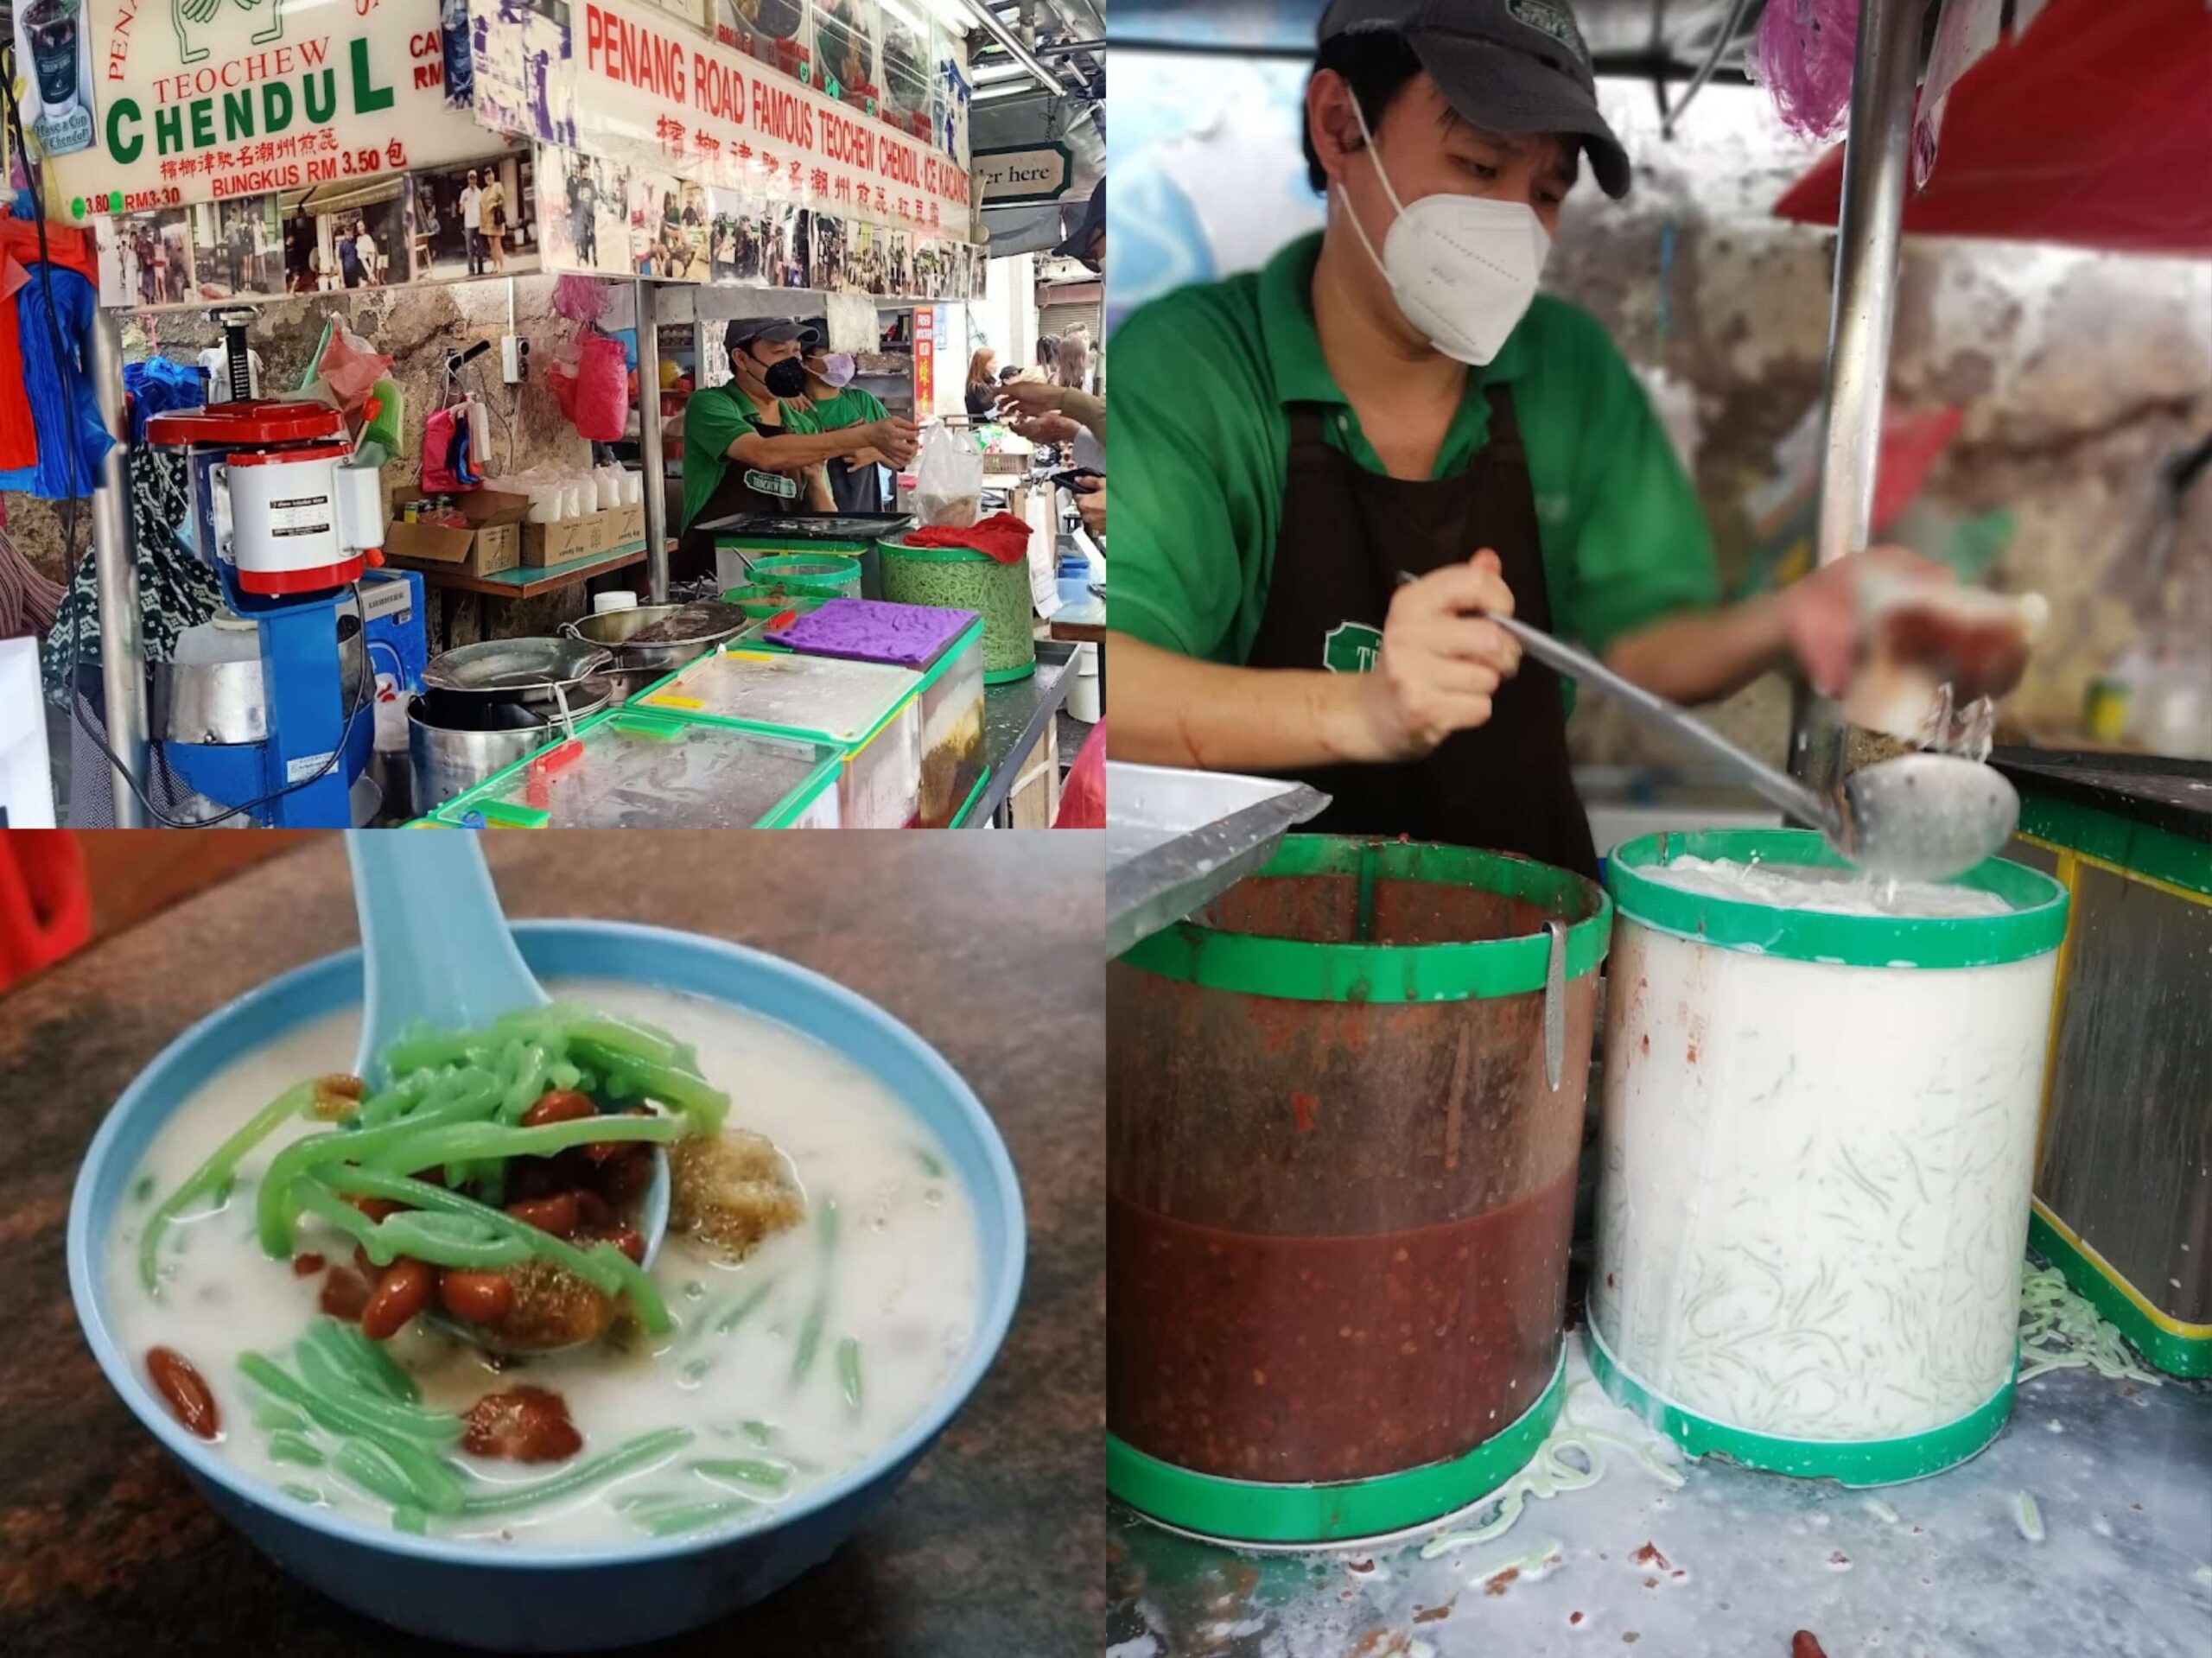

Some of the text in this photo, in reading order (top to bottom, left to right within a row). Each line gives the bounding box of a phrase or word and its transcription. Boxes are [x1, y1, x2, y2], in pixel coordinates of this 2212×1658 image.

[108, 0, 137, 82] PEN
[152, 36, 331, 105] TEOCHEW
[106, 37, 395, 165] CHENDUL
[586, 3, 685, 104] PENANG
[694, 52, 746, 124] ROAD
[753, 79, 813, 150] FAMOUS
[818, 109, 874, 172] TEOCHEW
[879, 136, 920, 188] CHENDUL
[925, 156, 937, 194] ICE
[939, 162, 969, 205] KACANG
[212, 137, 407, 198] BUNGKUS RM 3.50 包
[1009, 166, 1050, 182] here
[86, 194, 109, 214] 3.80
